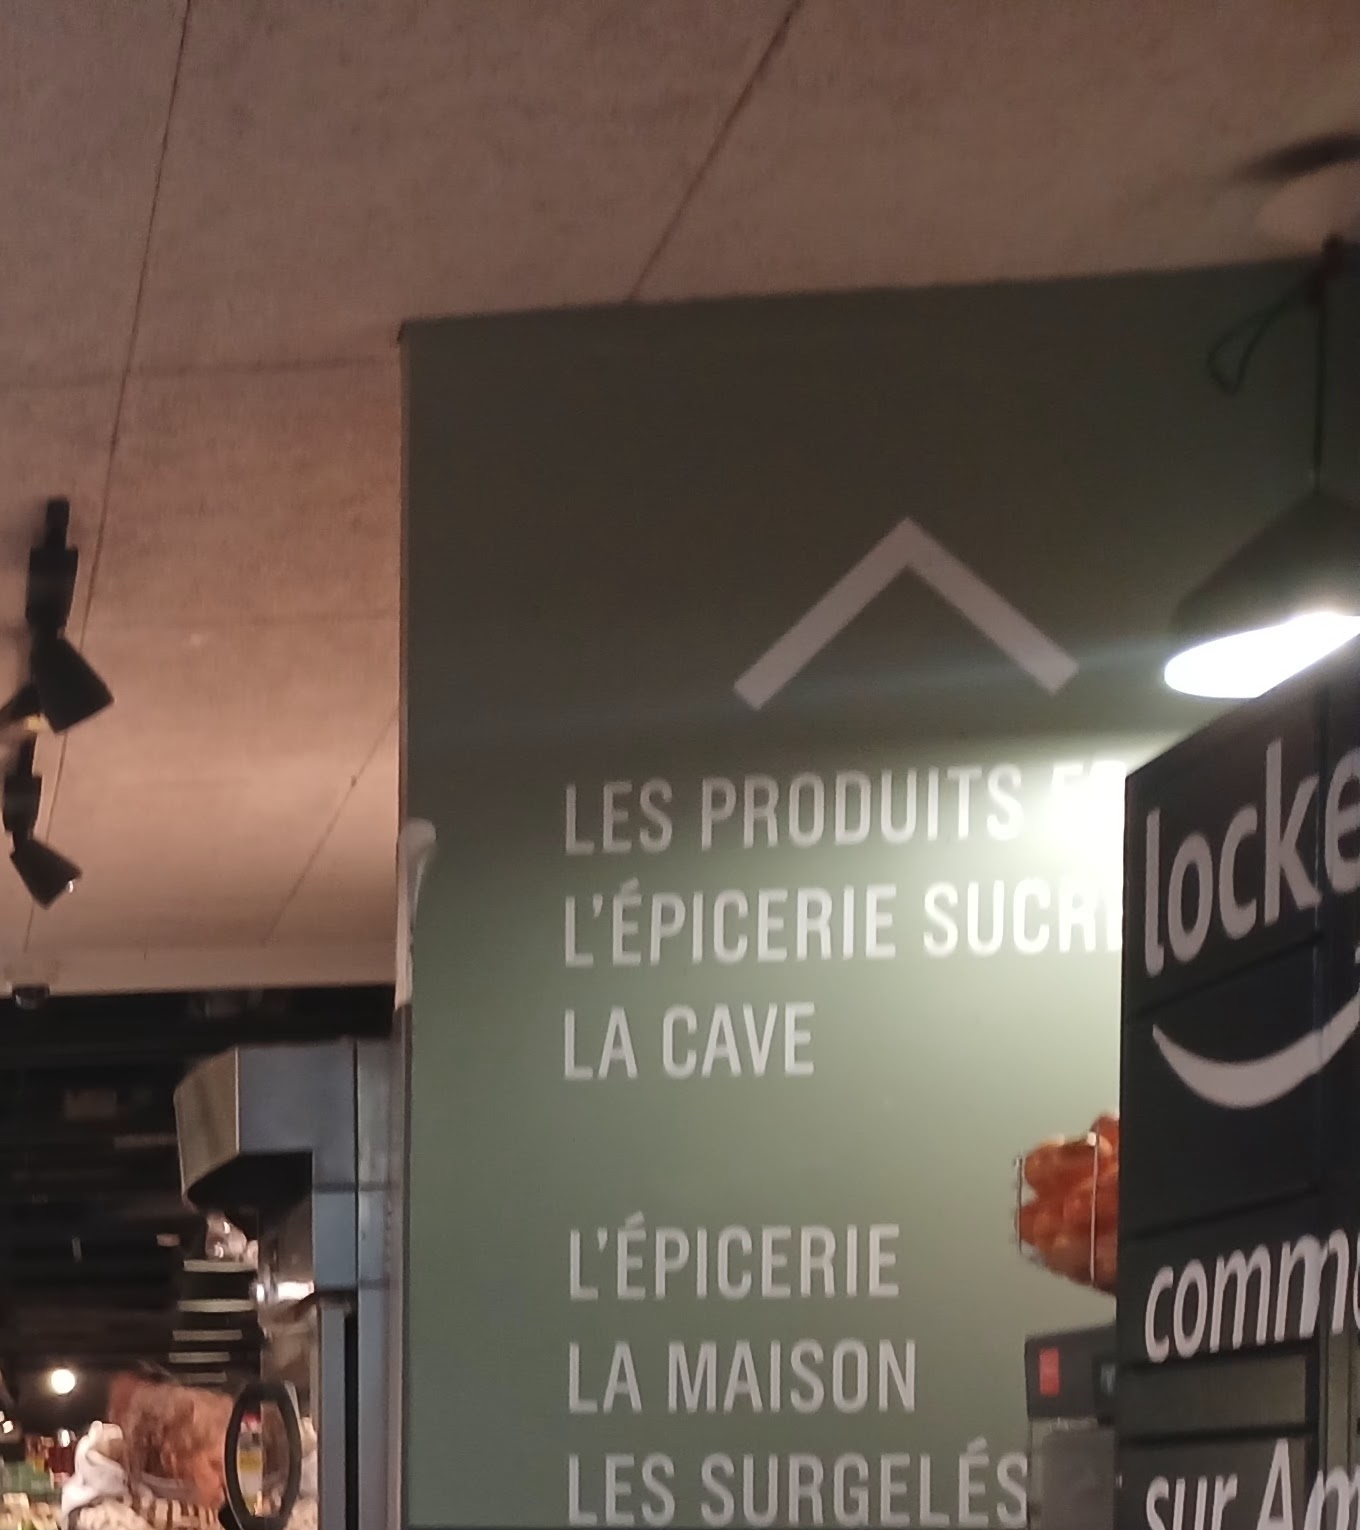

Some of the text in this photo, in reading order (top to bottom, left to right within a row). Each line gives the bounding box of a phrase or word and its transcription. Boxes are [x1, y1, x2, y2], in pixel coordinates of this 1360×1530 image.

[564, 779, 674, 856] LES
[700, 763, 1023, 850] PRODUITS
[564, 877, 898, 967] L'ÉPICERIE
[564, 1002, 815, 1080] LA CAVE
[569, 1211, 900, 1300] L'ÉPICERIE
[1145, 1227, 1360, 1364] comm
[568, 1337, 916, 1413] LA MAISON
[568, 1436, 1028, 1529] LES SURGELÉS
